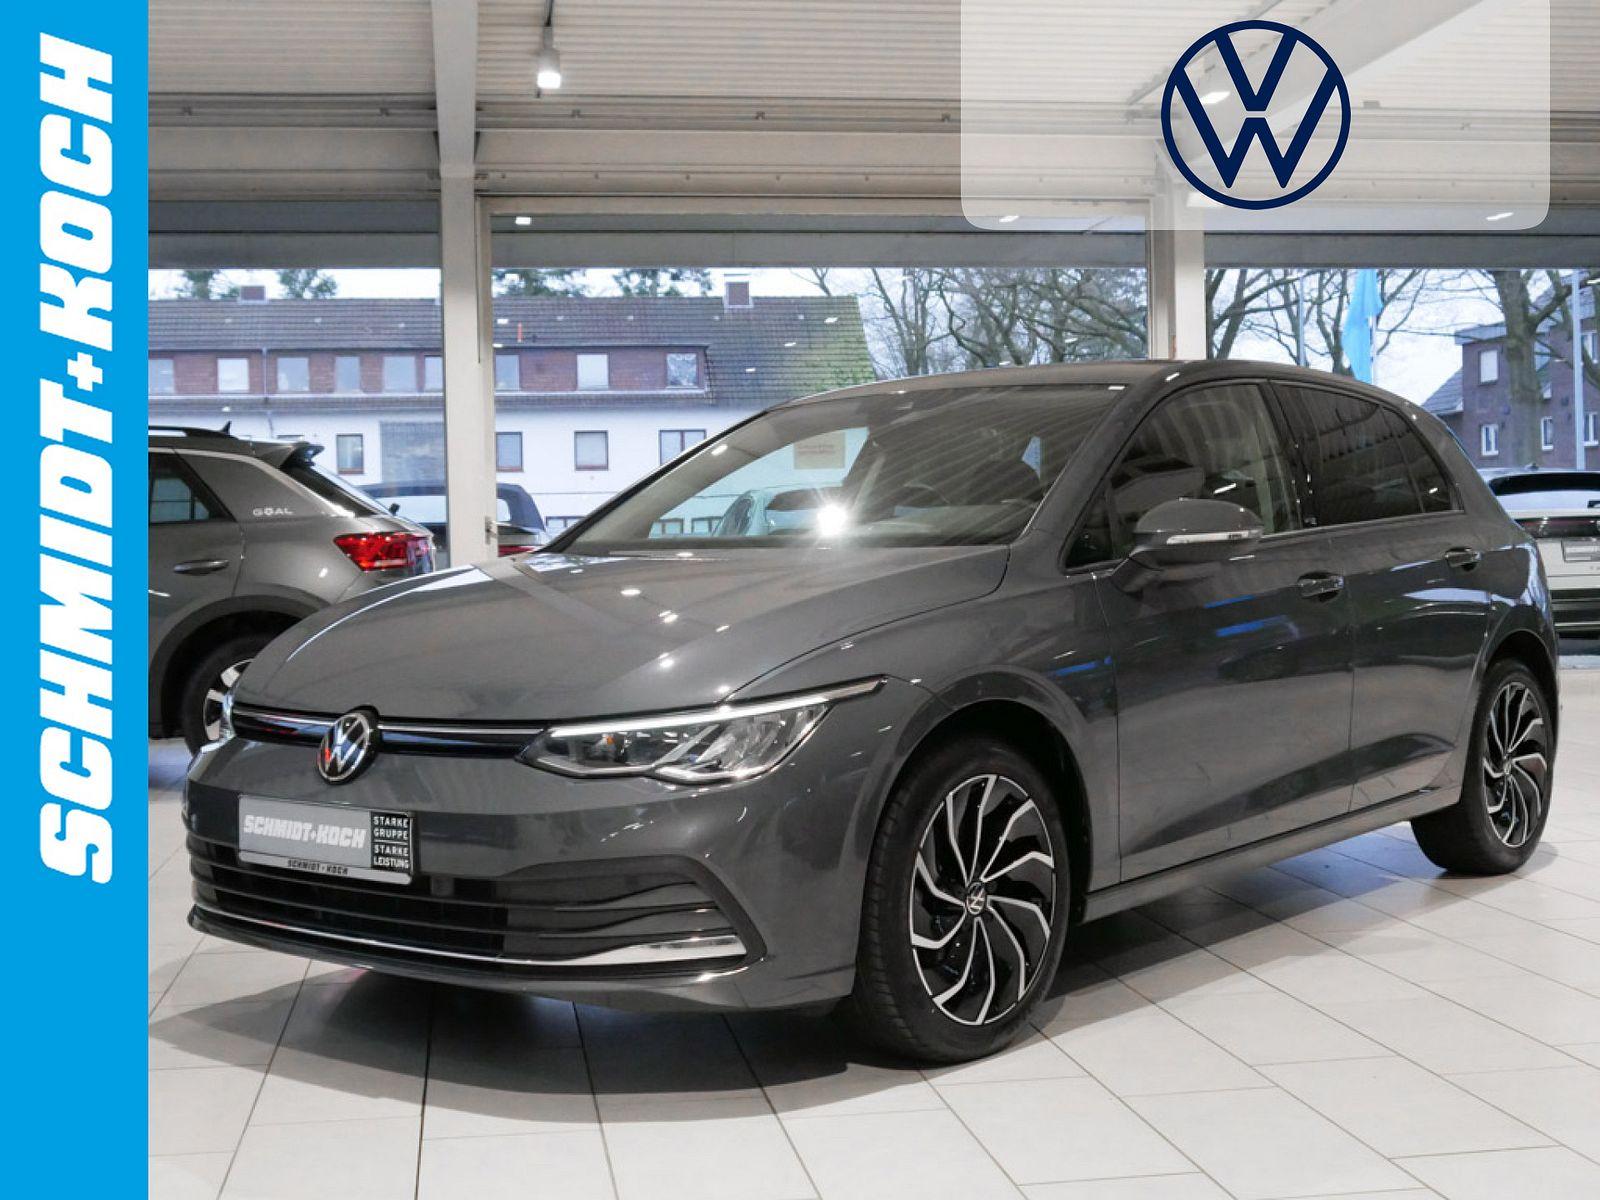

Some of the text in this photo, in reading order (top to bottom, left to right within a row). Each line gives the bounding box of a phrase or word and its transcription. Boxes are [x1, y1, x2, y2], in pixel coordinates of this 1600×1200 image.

[252, 507, 294, 516] GOAL
[373, 816, 409, 828] STARKE
[373, 828, 409, 840] GRUPPE
[373, 844, 409, 857] STARKE
